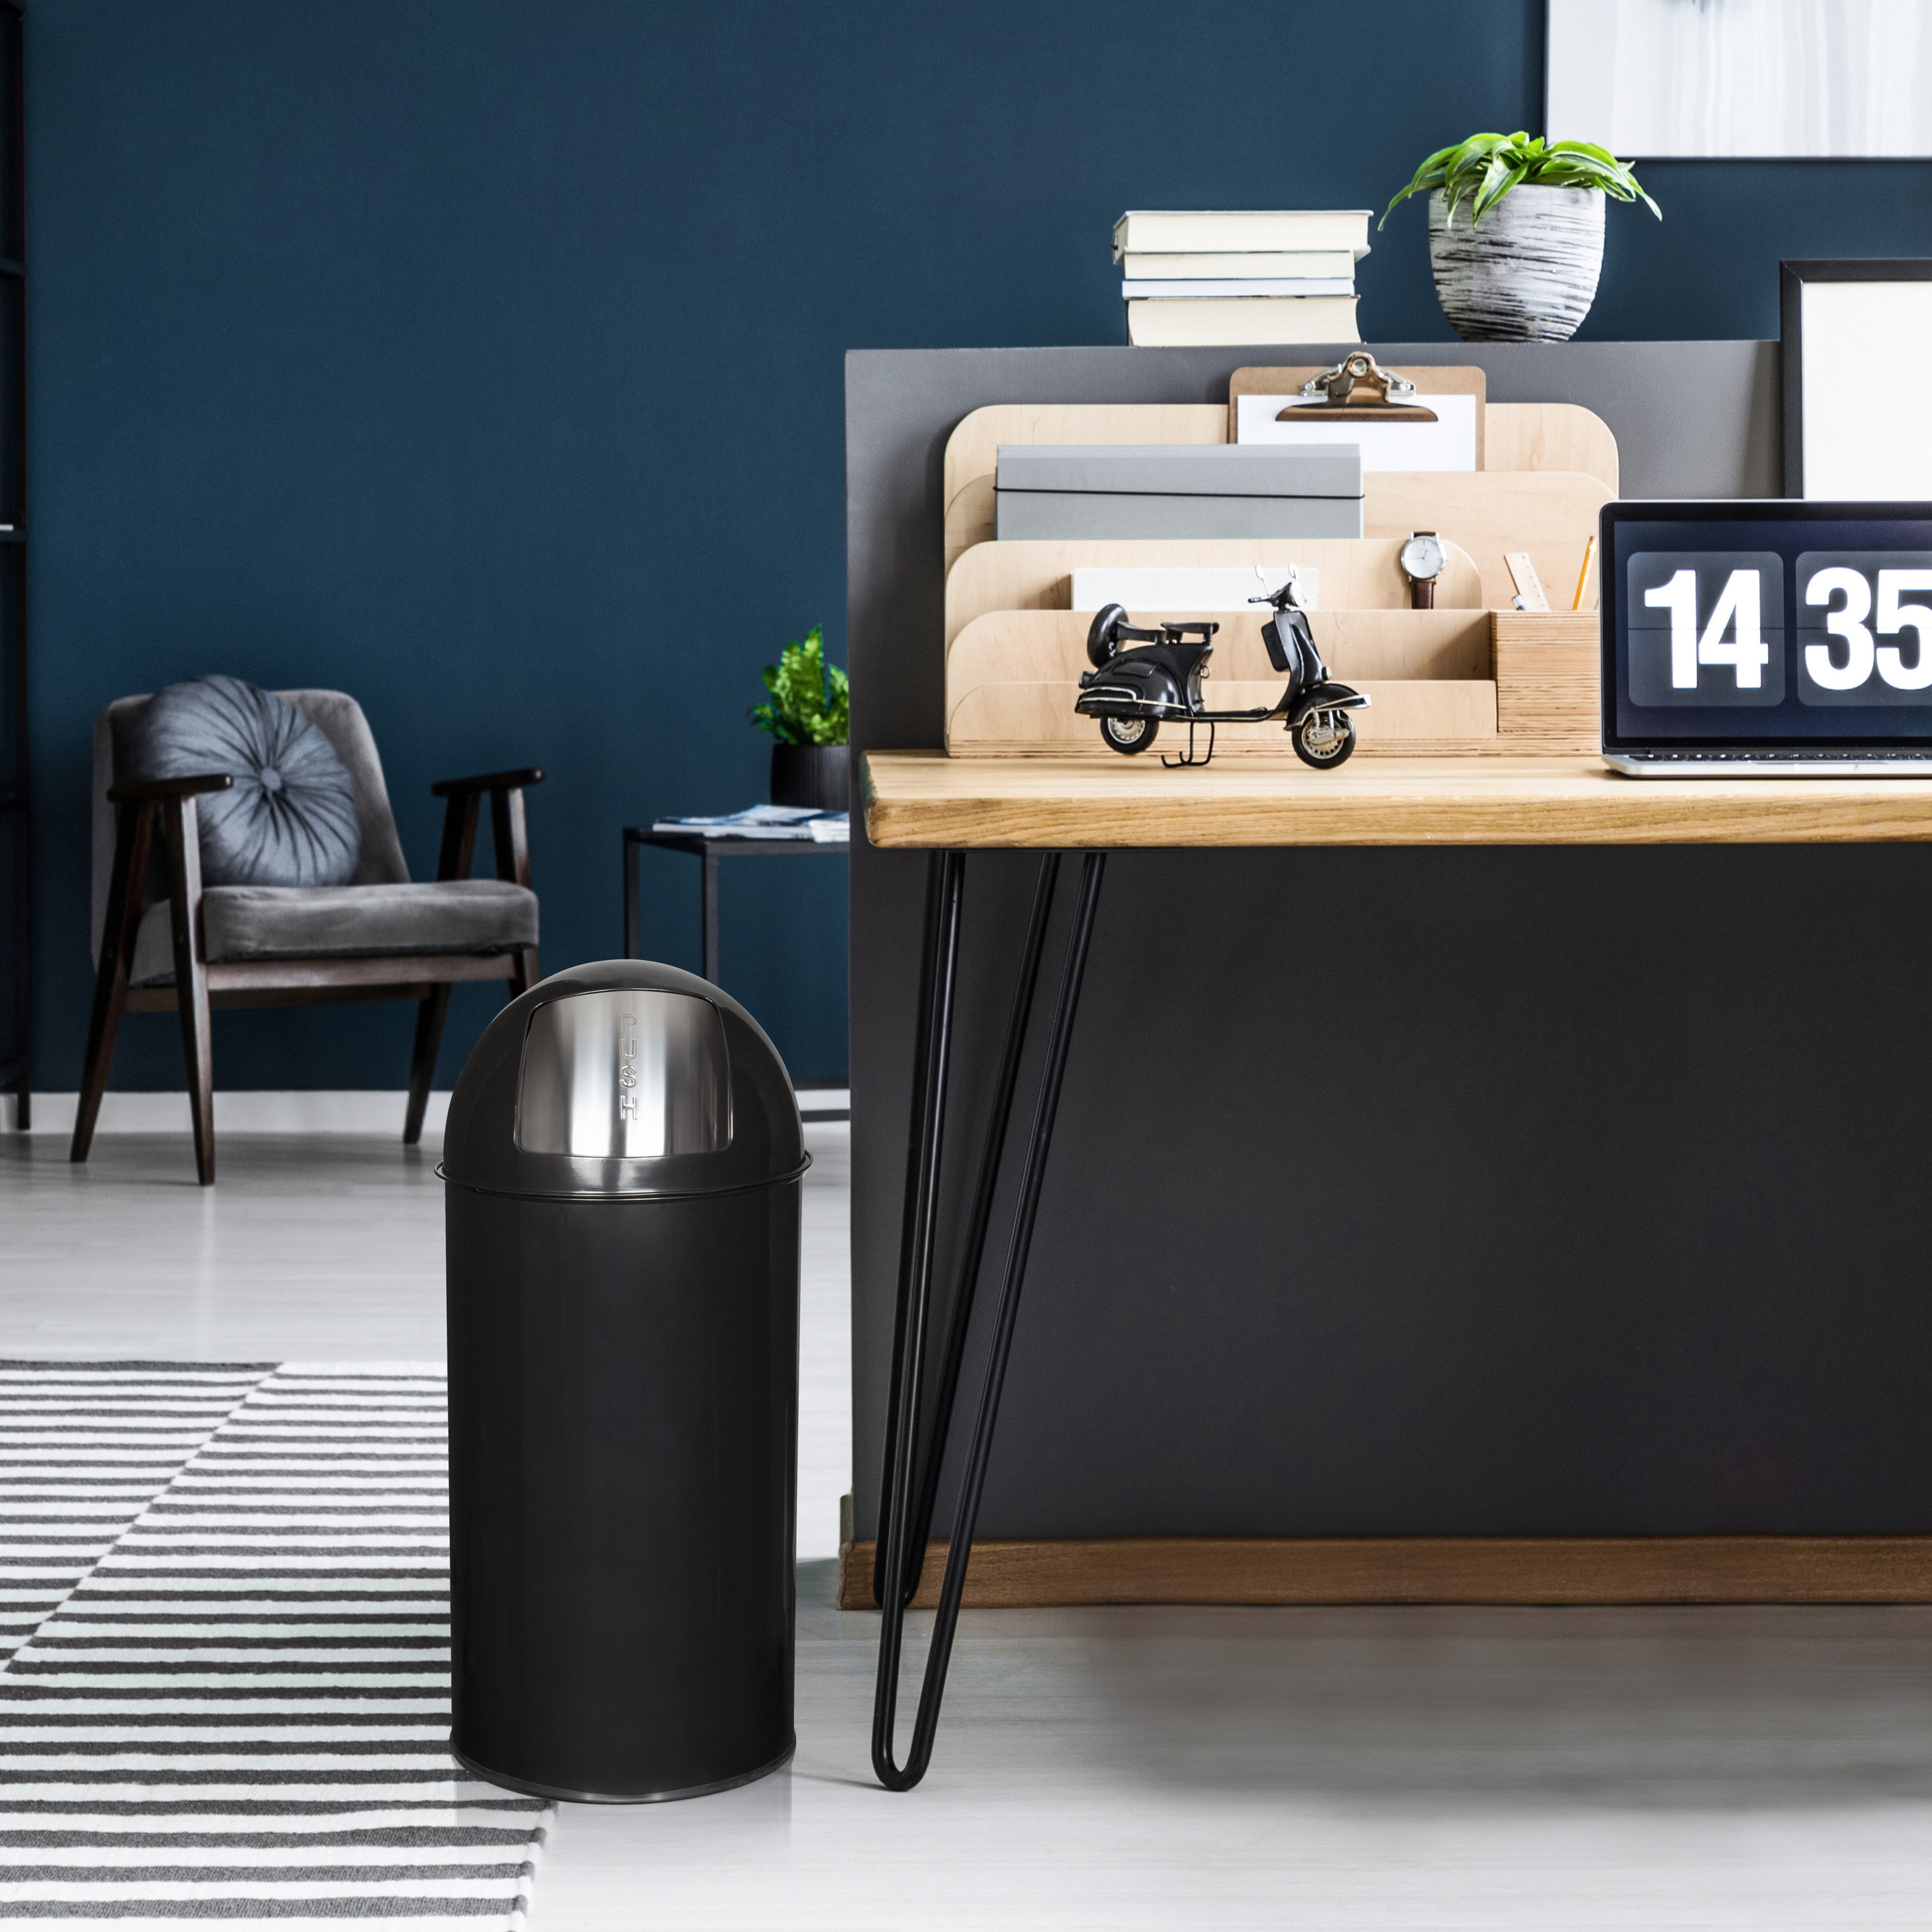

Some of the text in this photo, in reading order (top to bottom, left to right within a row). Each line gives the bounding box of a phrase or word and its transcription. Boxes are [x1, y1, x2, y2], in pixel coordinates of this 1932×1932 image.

[1644, 569, 1768, 688] 14
[1804, 567, 1932, 690] 35
[619, 1014, 638, 1120] PUSH
